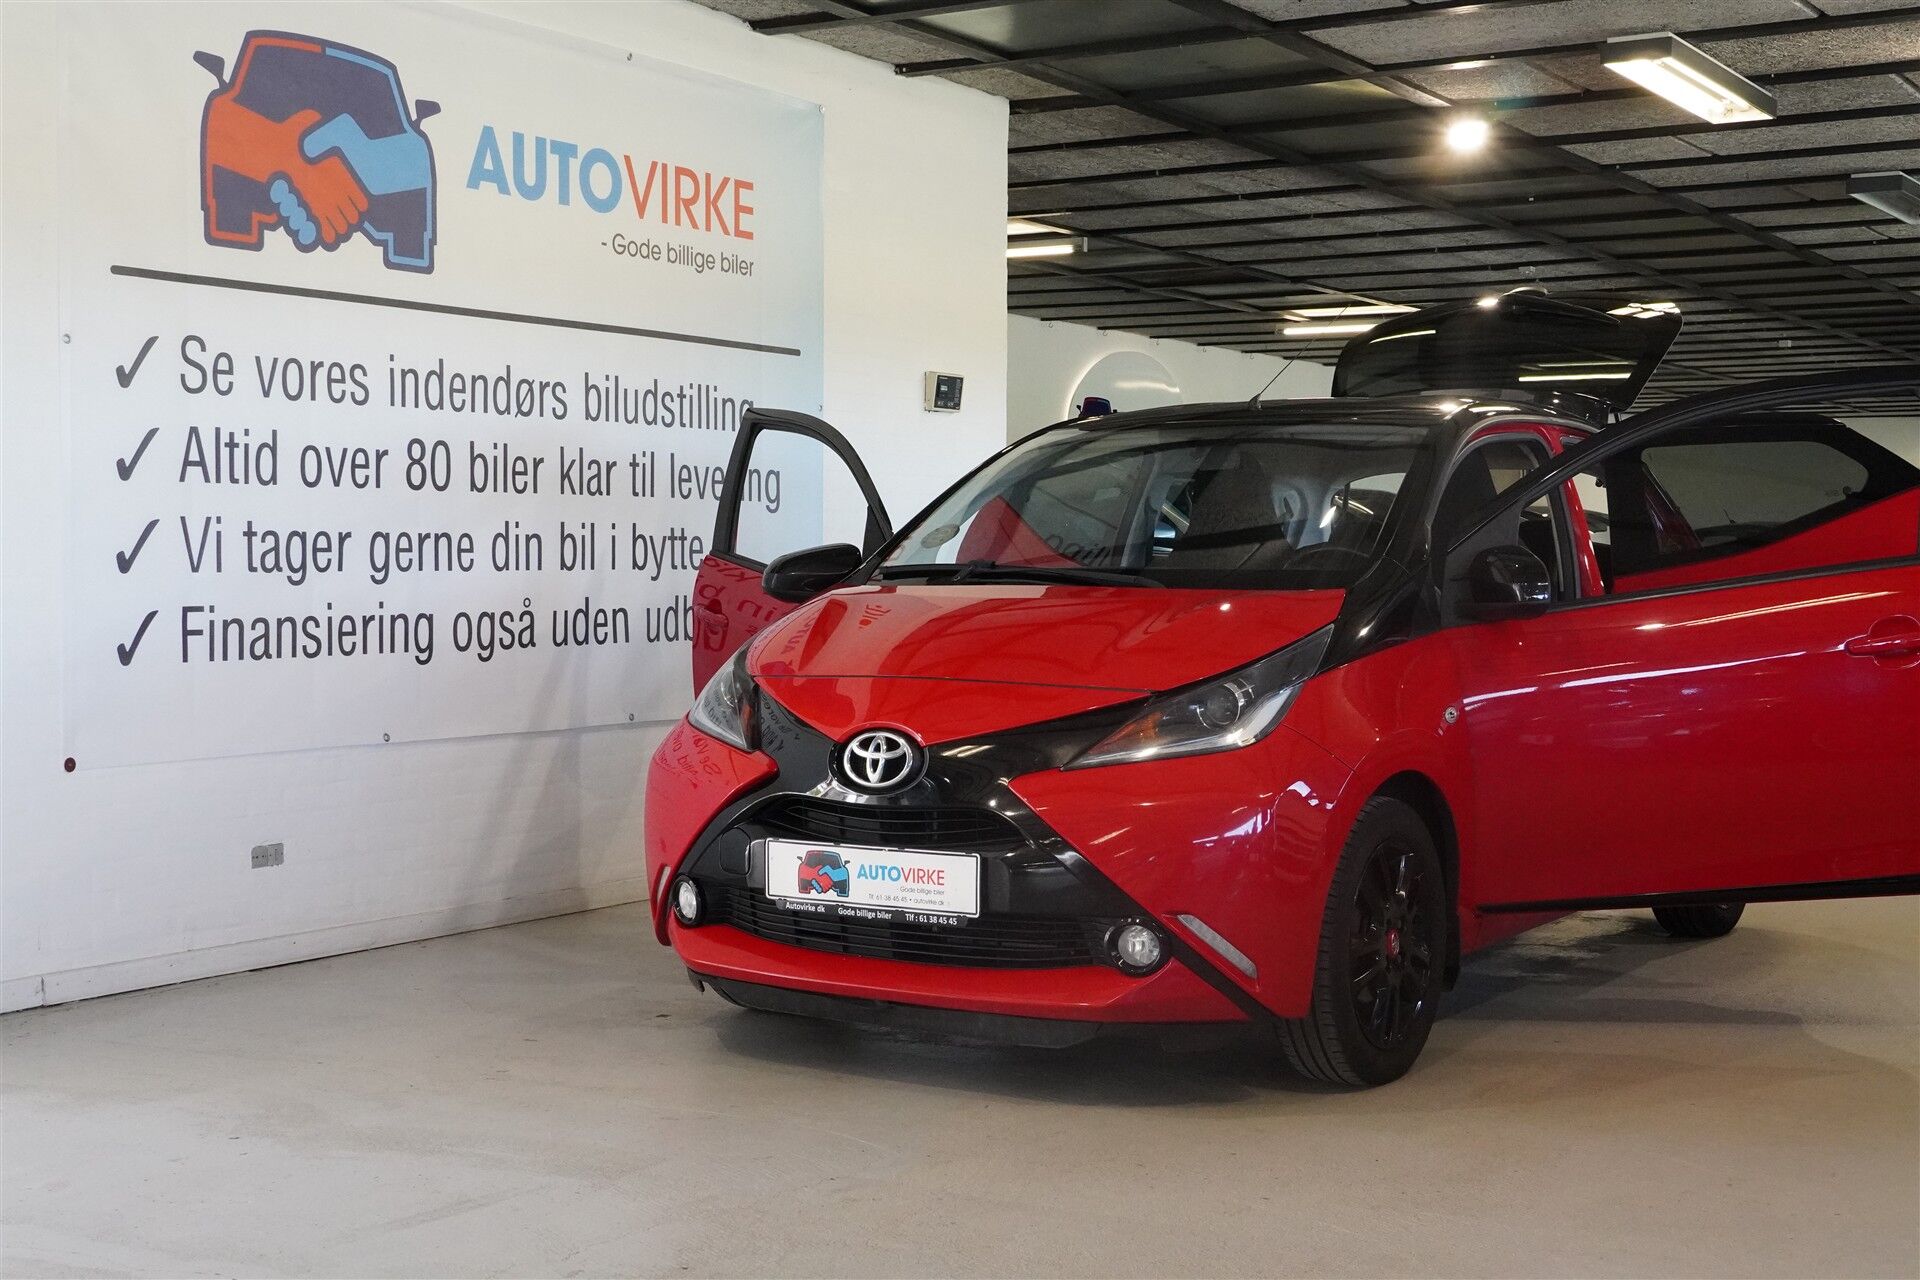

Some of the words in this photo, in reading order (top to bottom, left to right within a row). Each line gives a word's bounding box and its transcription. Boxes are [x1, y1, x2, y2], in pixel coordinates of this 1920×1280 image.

[466, 125, 754, 240] AUTOVIRKE
[612, 233, 661, 261] Gode
[667, 242, 715, 274] billige
[720, 252, 754, 277] biler
[180, 335, 234, 397] Se
[255, 355, 370, 405] vores
[389, 354, 568, 421] indendørs
[179, 427, 278, 487] Altid
[301, 445, 389, 489] over
[405, 438, 452, 492] 80
[469, 440, 545, 494] biler
[559, 446, 618, 497] klar
[628, 450, 655, 498] til
[670, 452, 781, 513] leveng
[180, 515, 222, 573] Vi
[243, 520, 352, 587] tager
[369, 531, 475, 586] gerne
[491, 520, 543, 572] din
[559, 521, 595, 572] bil
[611, 521, 617, 571] i
[631, 522, 704, 581] bytte
[181, 602, 434, 666] Finansiering
[453, 597, 537, 663] også
[552, 596, 630, 648] uden
[857, 863, 945, 886] AUTOVIRKE
[837, 907, 856, 916] Gode
[856, 909, 876, 919] billige
[876, 911, 892, 920] biler
[919, 914, 928, 923] 61
[928, 915, 938, 924] 38
[938, 916, 948, 925] 45
[948, 917, 958, 926] 45
